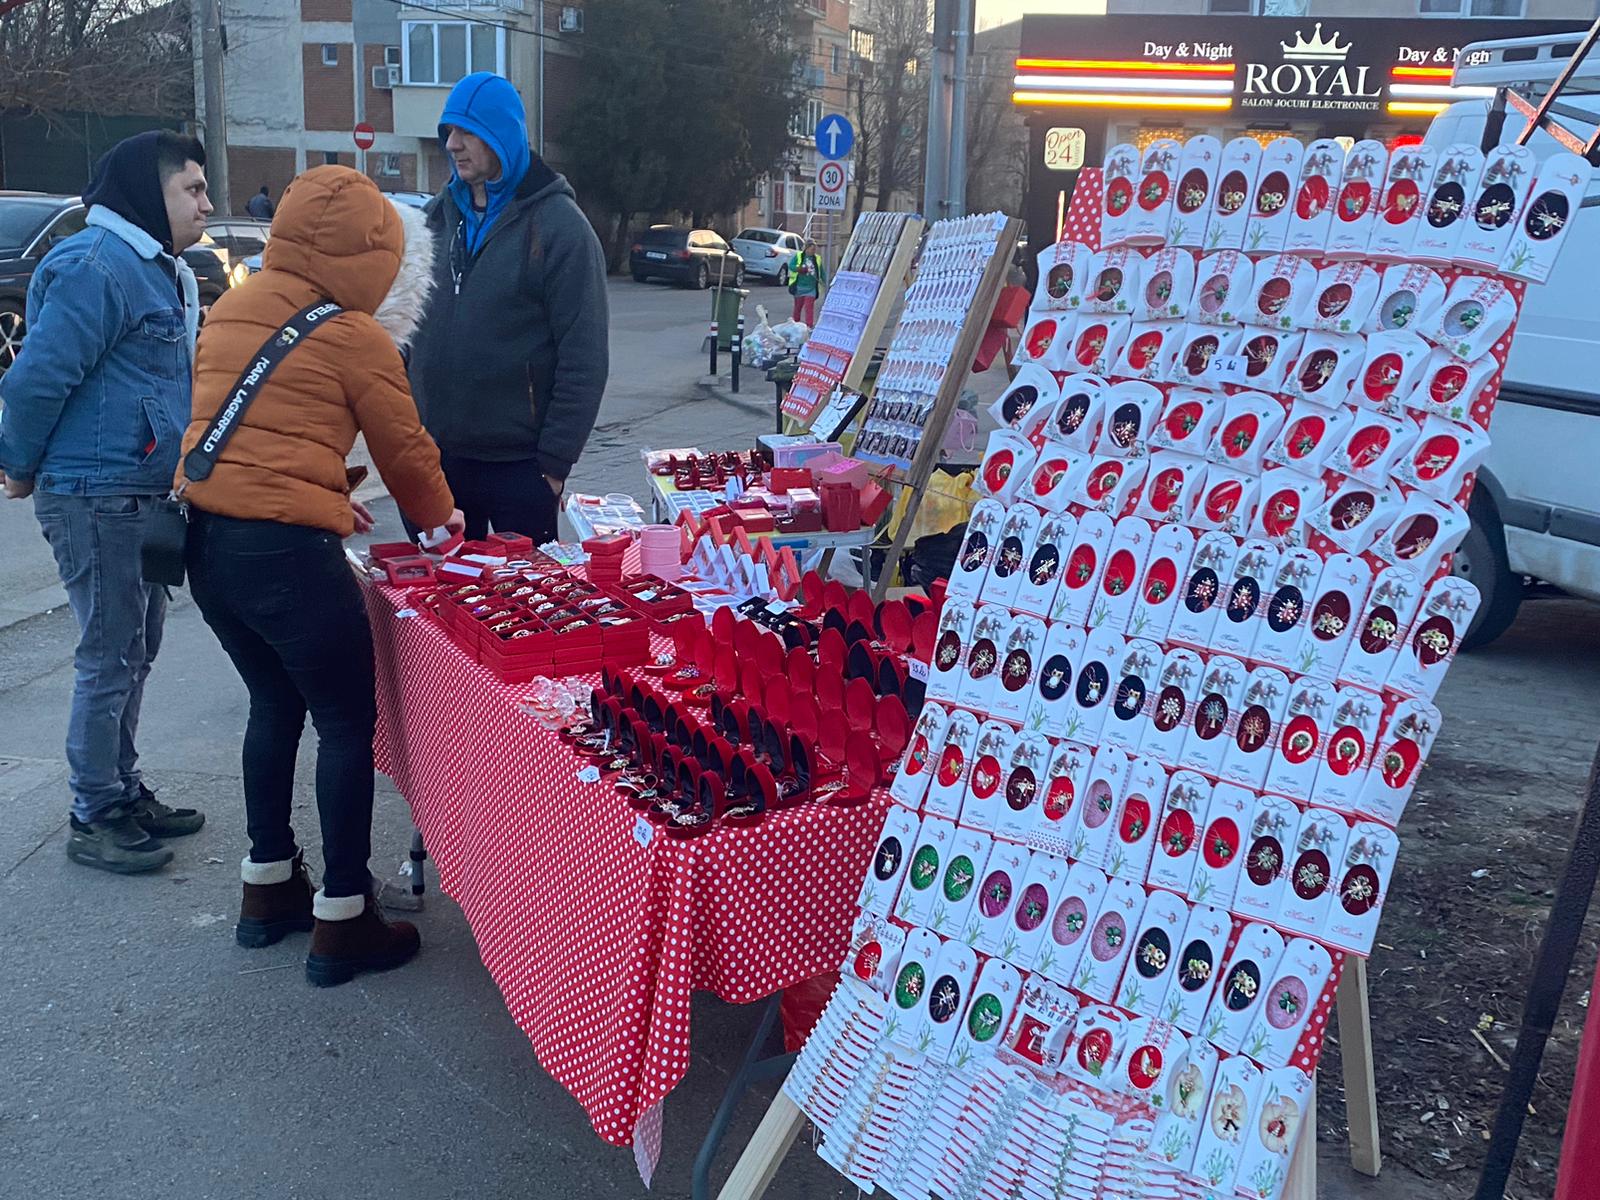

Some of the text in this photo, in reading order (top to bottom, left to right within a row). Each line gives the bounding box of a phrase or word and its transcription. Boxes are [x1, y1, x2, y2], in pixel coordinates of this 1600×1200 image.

[1143, 42, 1233, 60] Day & Night
[1398, 46, 1431, 65] Day
[1433, 47, 1448, 62] &
[1243, 64, 1383, 97] ROYAL
[1241, 98, 1380, 110] SALON JOCURI ELECTRONICE
[1046, 130, 1082, 149] Open
[1047, 144, 1073, 165] 24
[825, 170, 838, 184] 30
[818, 195, 841, 207] ZONA
[1214, 358, 1223, 371] 5
[203, 356, 270, 453] KARL LAGERFELD
